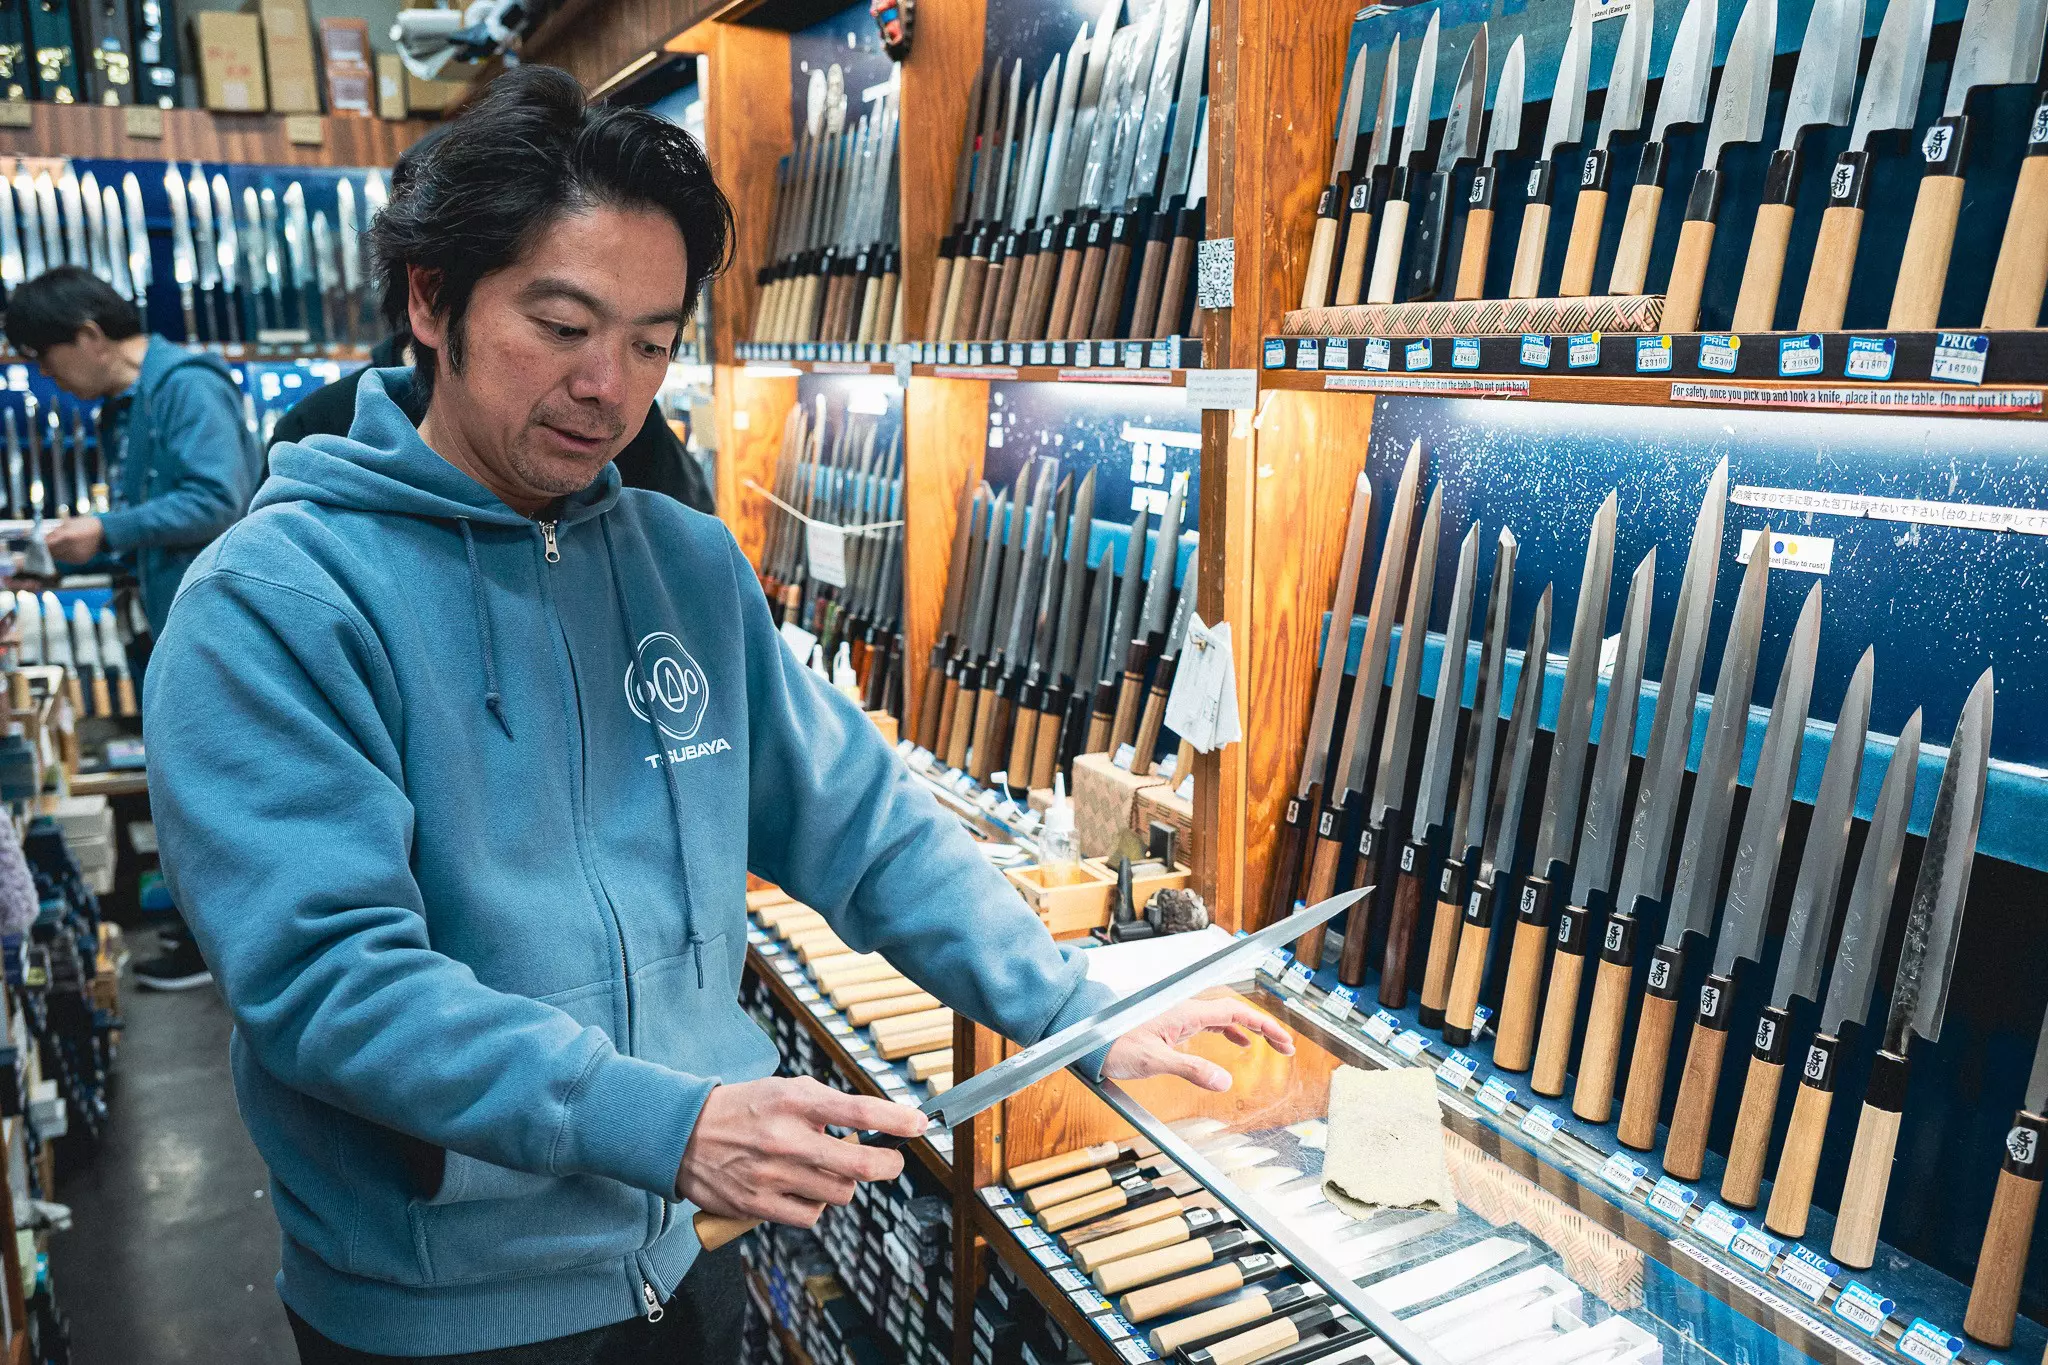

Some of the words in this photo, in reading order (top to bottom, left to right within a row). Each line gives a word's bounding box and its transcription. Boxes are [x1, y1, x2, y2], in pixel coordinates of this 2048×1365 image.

[1525, 336, 1544, 345] PRIC
[1571, 337, 1593, 345] PRIC
[1640, 340, 1663, 348] PRIC
[1704, 336, 1729, 346] PRIC
[1783, 340, 1810, 349] PRIC
[1853, 341, 1884, 351] PRIC
[1940, 333, 1977, 349] PRIC
[1709, 356, 1733, 367] 25300
[1792, 356, 1819, 369] 30800
[1859, 360, 1888, 370] 41800
[1673, 385, 1685, 396] For
[1685, 385, 1709, 401] safety,
[1709, 388, 1727, 400] once
[1728, 389, 1742, 402] you
[1743, 389, 1760, 403] pick
[1761, 391, 1771, 403] up
[1772, 390, 1788, 403] and
[1790, 390, 1809, 403] look
[1810, 392, 1817, 403] a
[1818, 391, 1843, 405] knife,
[1845, 391, 1868, 406] place
[1870, 391, 1878, 405] it
[1880, 394, 1891, 405] on
[1894, 392, 1909, 405] the
[1911, 392, 1937, 406] table.
[1940, 391, 1957, 407] (Do
[1959, 393, 1975, 407] not
[1978, 393, 1996, 409] put
[1999, 391, 2007, 407] it
[2010, 391, 2041, 408] back)
[1782, 557, 1800, 567] (Easy
[1808, 561, 1826, 570] rust)
[1334, 985, 1354, 1002] PRIC
[1376, 1009, 1394, 1026] PRIC
[1450, 1051, 1470, 1069] PRIC
[1710, 1206, 1734, 1222] PRIC
[1743, 1227, 1771, 1245] PRIC
[1793, 1244, 1827, 1273] PRIC
[1787, 1271, 1813, 1292] 39600
[1849, 1285, 1881, 1308] PRIC
[1114, 1314, 1134, 1332] PRIC
[1846, 1305, 1876, 1326] 39600
[1913, 1323, 1948, 1348] PRIC
[1135, 1338, 1155, 1357] PRIC
